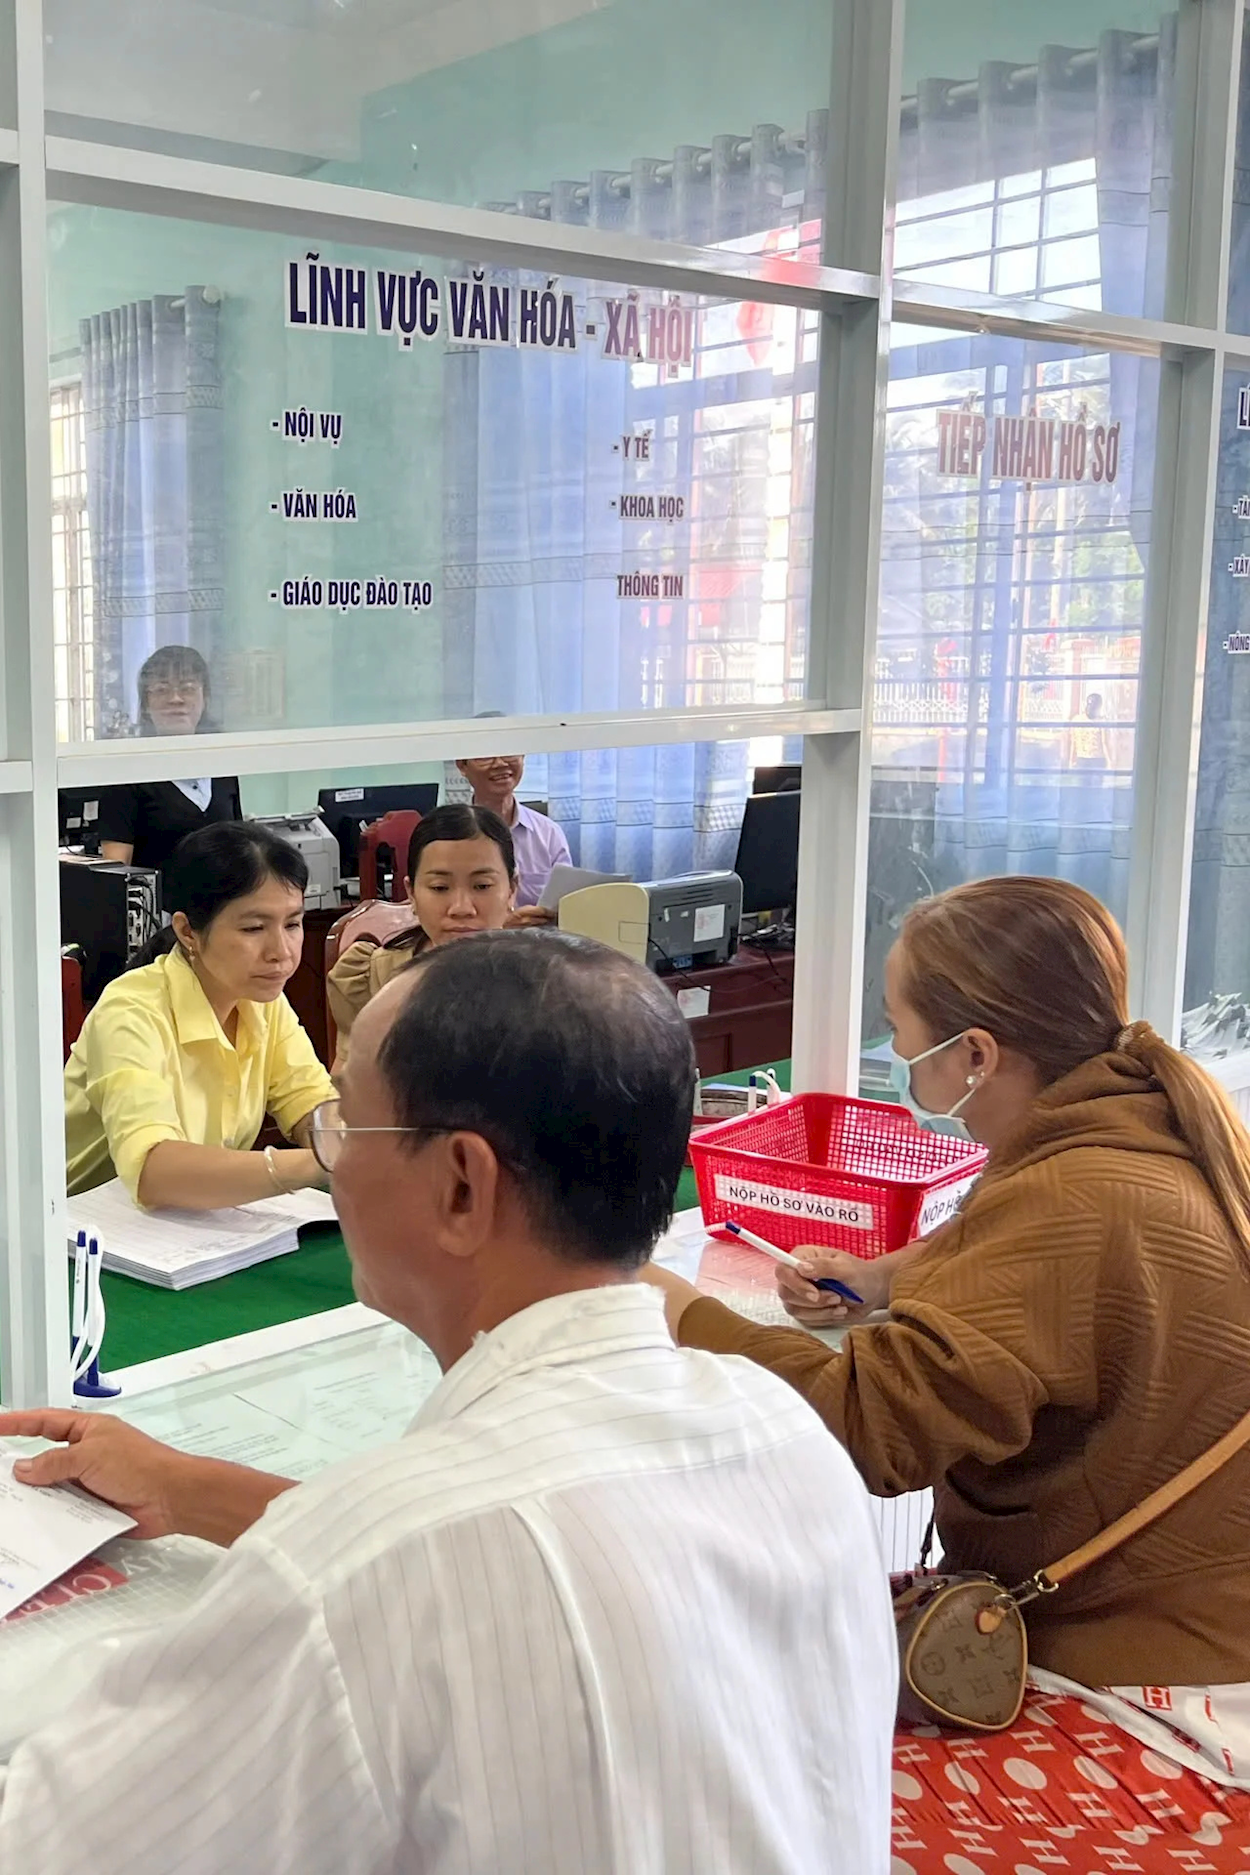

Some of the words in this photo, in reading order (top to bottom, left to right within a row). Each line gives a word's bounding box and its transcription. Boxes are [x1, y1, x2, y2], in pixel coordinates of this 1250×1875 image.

[289, 253, 366, 328] LĨNH
[378, 269, 438, 346] VỰC
[450, 272, 509, 341] VĂN
[521, 279, 576, 348] HÓA
[604, 292, 643, 358] XÃ
[649, 296, 691, 376] HỘI
[285, 408, 314, 443] NỘI
[321, 415, 341, 445] VỤ
[939, 391, 987, 474] TIẾP
[993, 406, 1054, 491] NHẬN
[1059, 402, 1088, 481] HỒ
[1093, 422, 1120, 482] SƠ
[622, 438, 632, 458] Y
[635, 429, 650, 460] TẾ
[283, 489, 317, 518] VĂN
[324, 490, 356, 518] HÓA
[621, 496, 654, 518] KHOA
[659, 496, 683, 525] HỌC
[283, 576, 322, 605] GIÁO
[328, 582, 360, 612] DỤC
[366, 576, 398, 605] ĐÀO
[403, 581, 432, 611] TẠO
[618, 573, 658, 597] THÔNG
[662, 576, 683, 597] TIN
[730, 1187, 756, 1203] NỘP
[760, 1190, 780, 1206] HỒ
[783, 1198, 803, 1211] SƠ
[806, 1201, 835, 1217] VÀO
[921, 1200, 945, 1225] NỘP
